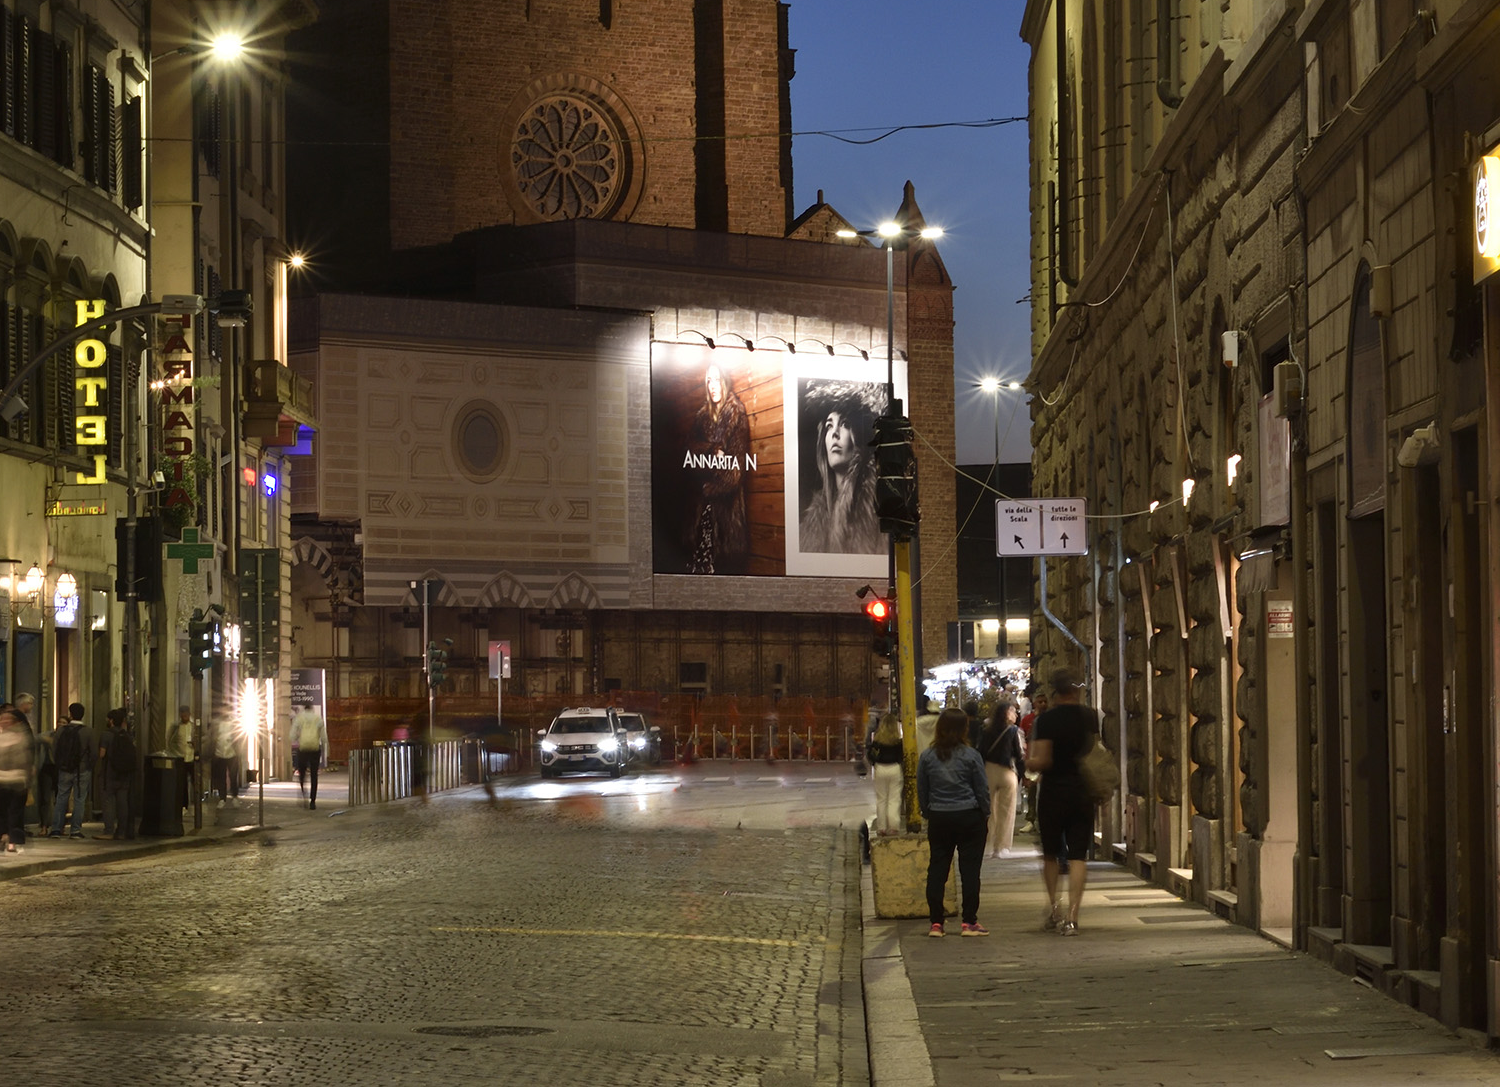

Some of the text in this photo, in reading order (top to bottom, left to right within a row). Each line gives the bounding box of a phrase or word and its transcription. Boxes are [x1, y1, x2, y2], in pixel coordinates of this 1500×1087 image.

[682, 449, 757, 472] ANNARITA N
[1016, 505, 1032, 513] della
[1010, 515, 1028, 523] Scala
[1050, 514, 1078, 522] direzioni
